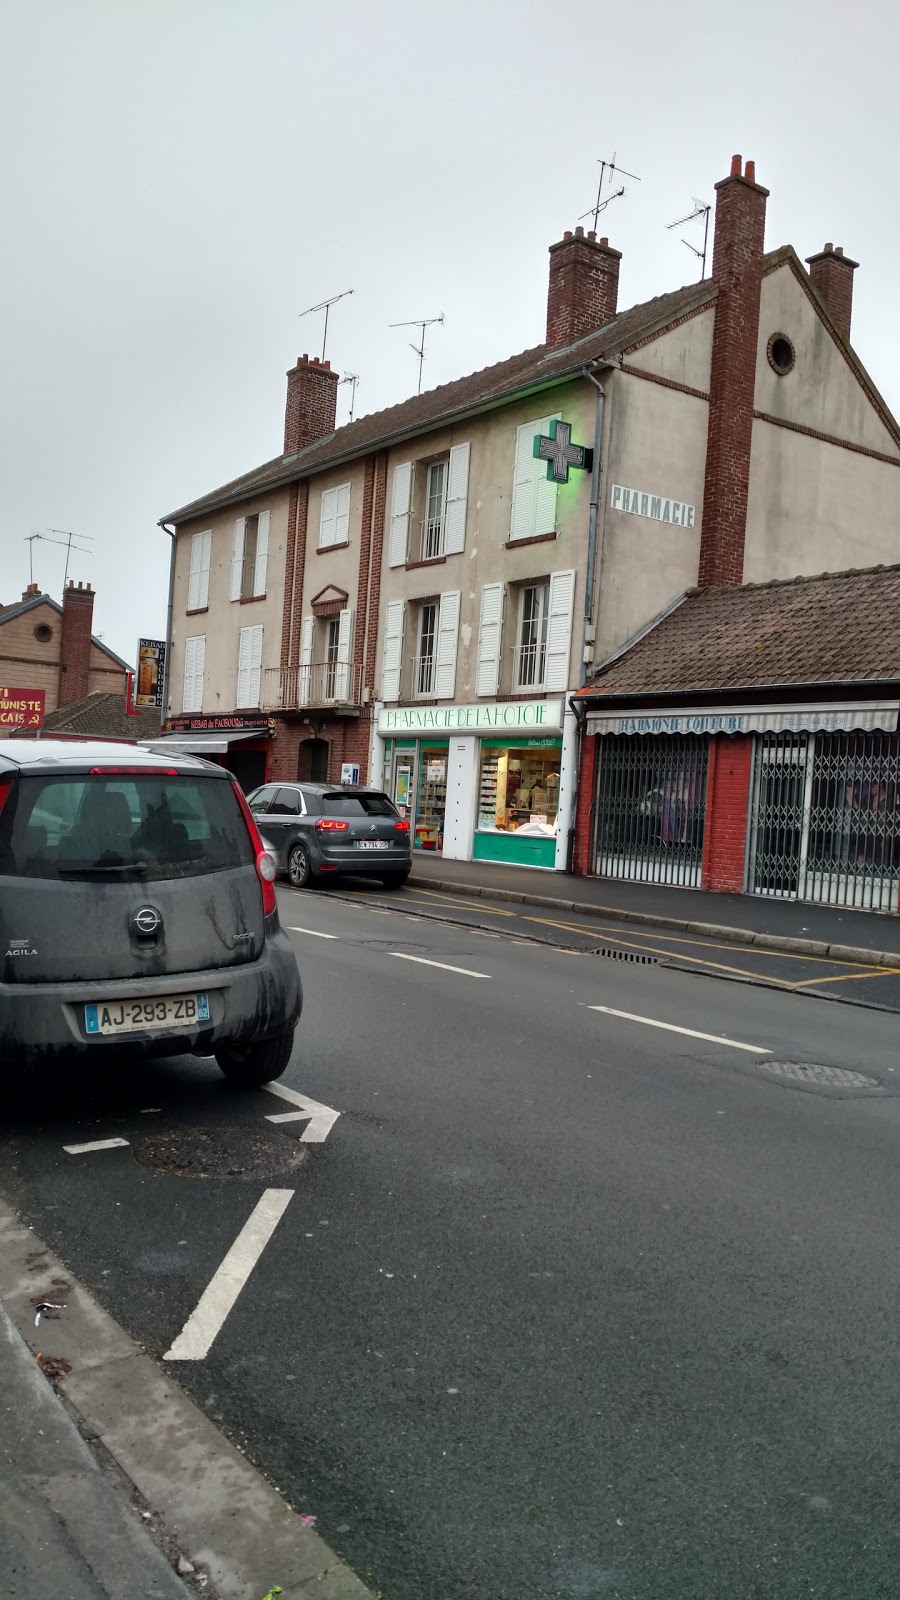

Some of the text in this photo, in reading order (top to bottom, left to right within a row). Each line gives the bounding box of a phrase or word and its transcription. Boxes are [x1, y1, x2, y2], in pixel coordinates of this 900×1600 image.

[613, 486, 694, 527] PHARMACIE
[140, 640, 166, 649] KEBAB
[191, 720, 207, 729] KEBAB
[215, 718, 244, 728] FAUBOURG
[387, 705, 547, 727] PHARMACIE DE LA HOTOIE
[621, 716, 744, 731] HARMONIE COIFFURE
[101, 999, 196, 1027] AJ-293-ZB
[198, 1008, 208, 1018] 62
